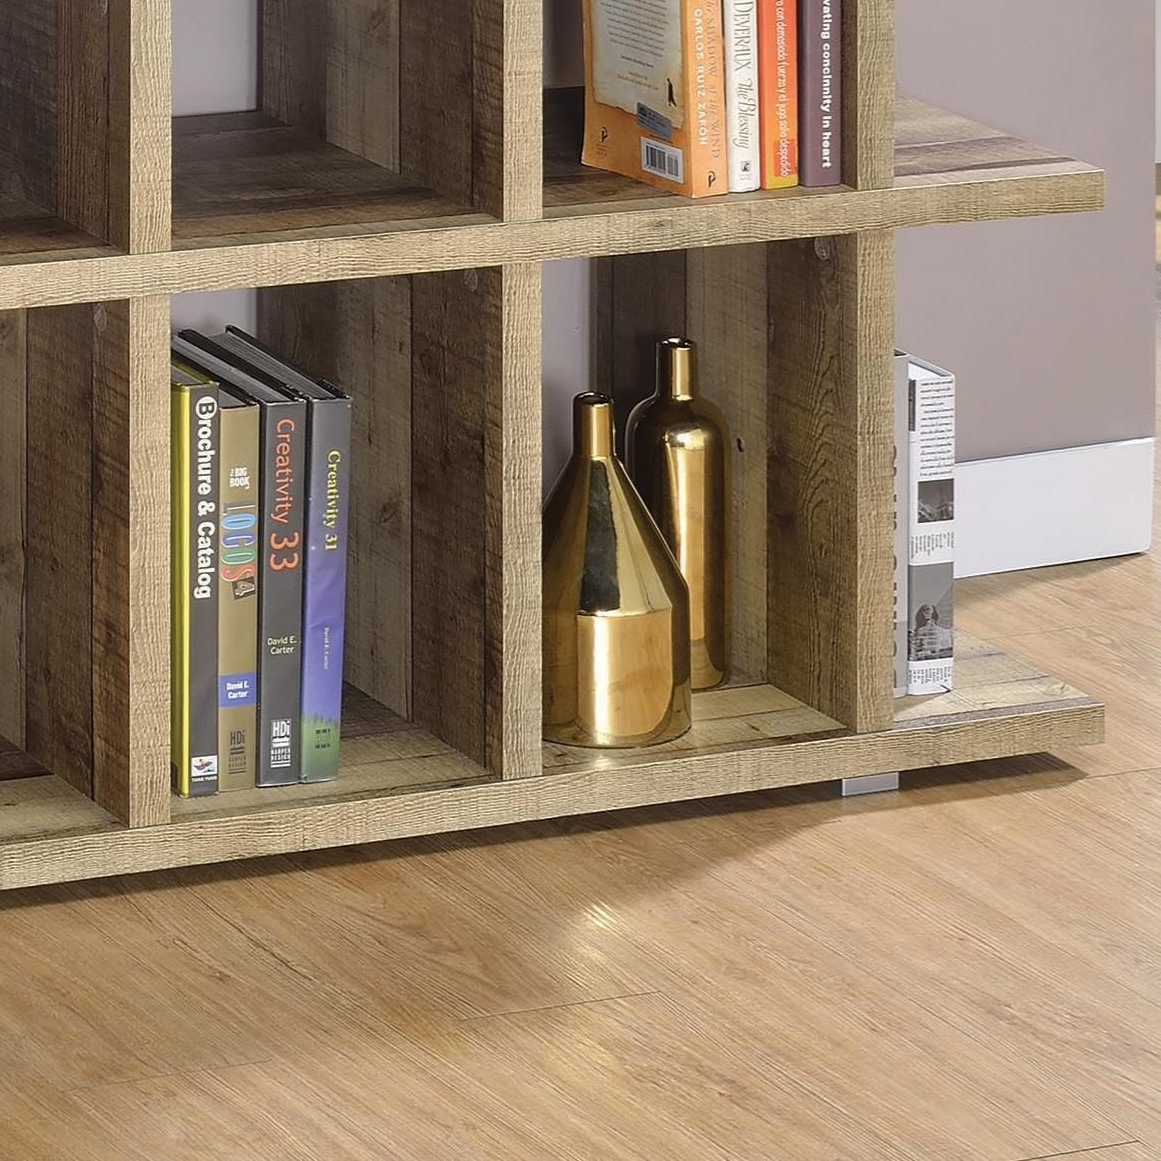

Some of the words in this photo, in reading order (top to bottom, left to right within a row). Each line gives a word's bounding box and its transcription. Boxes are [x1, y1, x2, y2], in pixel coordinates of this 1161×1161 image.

[694, 8, 705, 60] CARLOS
[706, 18, 719, 77] SHADOW
[733, 1, 755, 72] DEVERAUX
[696, 65, 707, 97] RUIZ
[820, 42, 833, 113] concinnity
[710, 119, 722, 159] WIND
[733, 99, 757, 150] Blessing
[822, 116, 832, 129] in
[821, 132, 832, 168] heart
[195, 396, 217, 496] Brochure
[275, 418, 295, 525] Creativity
[323, 450, 341, 530] Creativity
[198, 502, 215, 518] &
[193, 521, 216, 599] Catalog
[270, 532, 299, 571] 33
[324, 534, 339, 551] 31
[267, 636, 288, 646] David
[270, 646, 294, 654] Carter
